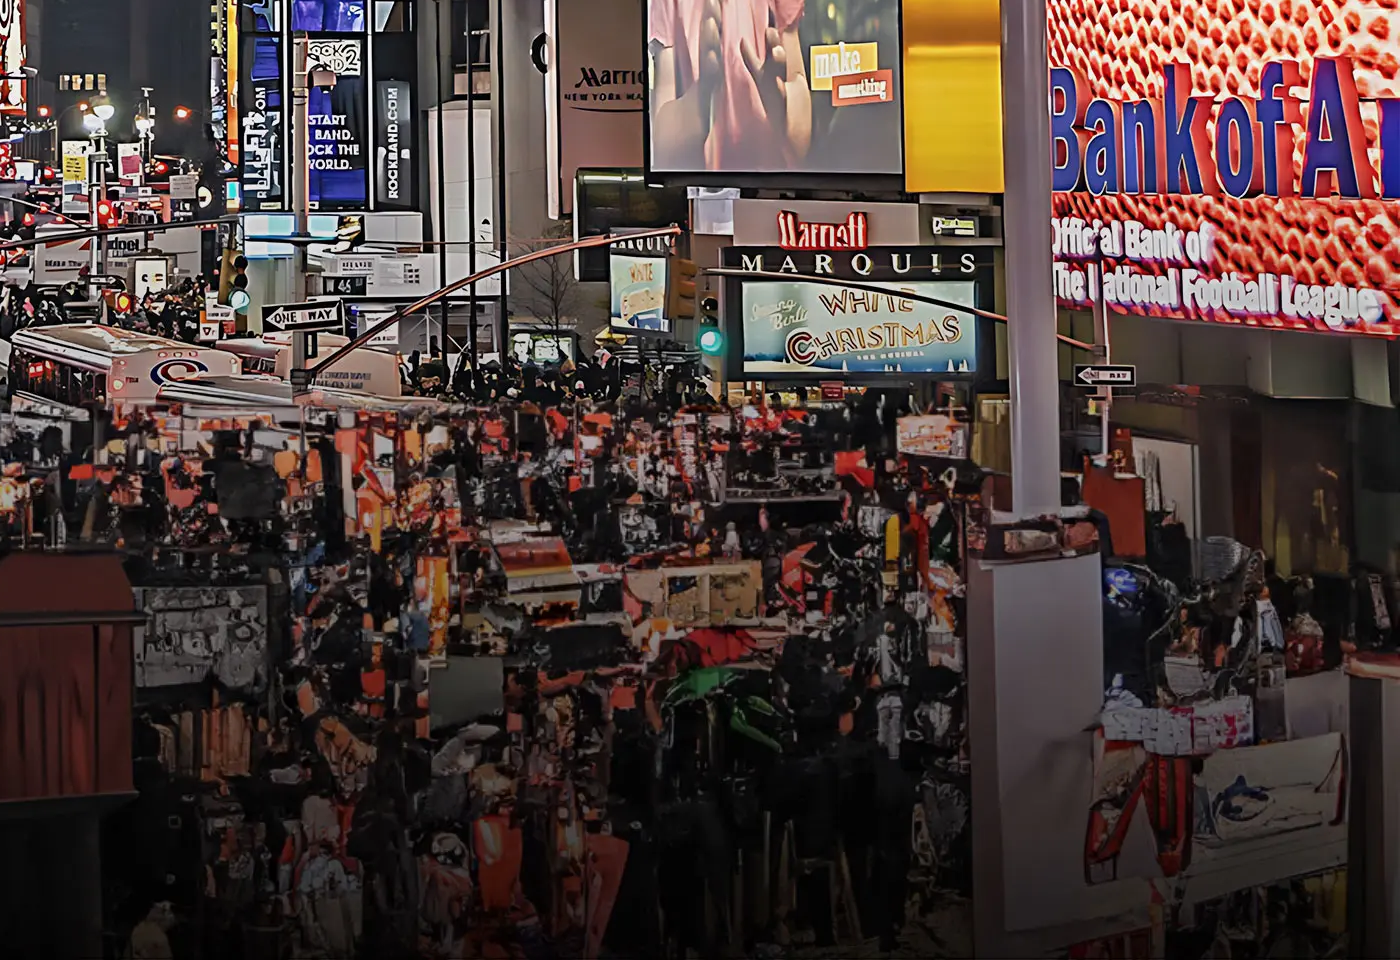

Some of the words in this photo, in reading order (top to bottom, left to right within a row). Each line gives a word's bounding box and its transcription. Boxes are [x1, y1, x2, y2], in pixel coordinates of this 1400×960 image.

[815, 41, 861, 78] make
[307, 114, 347, 126] START
[1050, 60, 1204, 196] Bank
[1215, 61, 1290, 199] of
[315, 129, 355, 141] BAND.
[338, 144, 360, 156] THE
[1124, 220, 1186, 261] Bank
[1185, 220, 1211, 263] of
[742, 253, 977, 275] MARQUIS
[819, 288, 916, 317] WHITE
[1182, 268, 1279, 315] Football
[1280, 276, 1383, 327] League
[273, 309, 298, 325] ONE
[308, 308, 333, 321] WAY
[786, 314, 963, 366] CHRISTMAS
